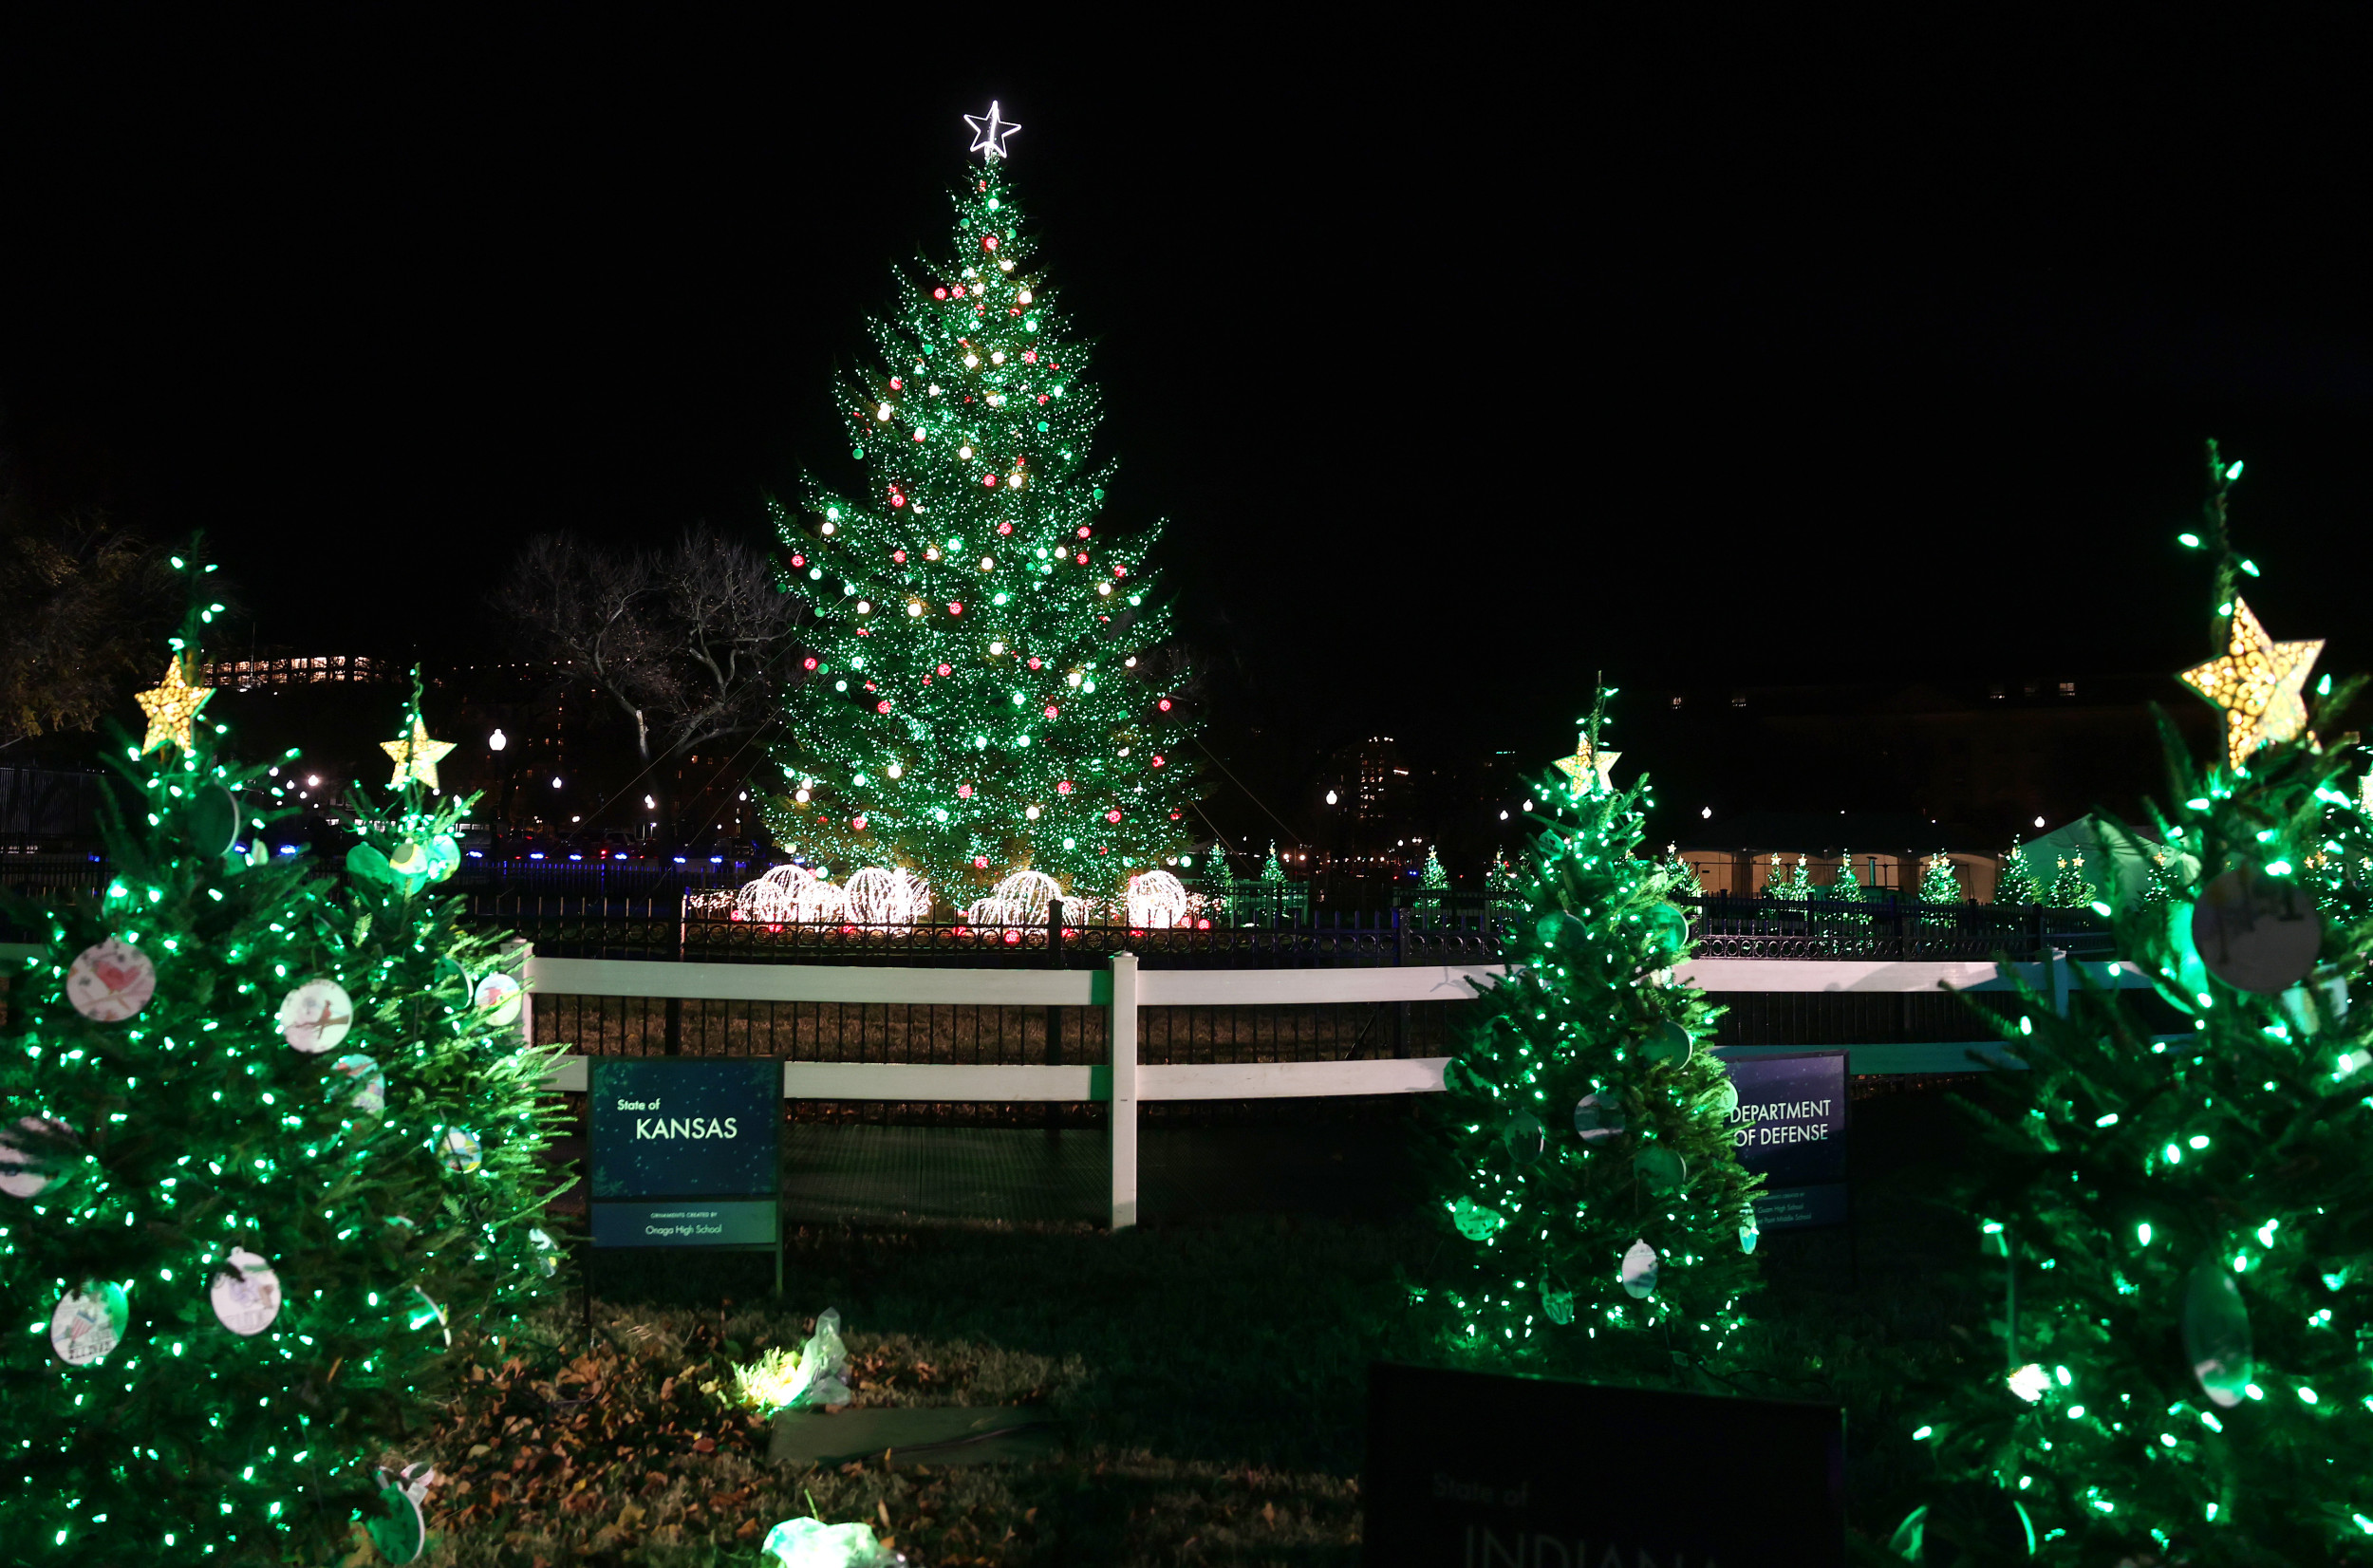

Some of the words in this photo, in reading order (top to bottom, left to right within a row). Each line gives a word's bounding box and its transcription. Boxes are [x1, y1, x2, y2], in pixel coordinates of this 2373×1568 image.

[617, 1099, 645, 1111] State
[647, 1098, 661, 1111] of
[1730, 1099, 1832, 1123] DEPARTMENT
[637, 1117, 738, 1140] KANSAS
[1733, 1129, 1756, 1147] OF
[1761, 1123, 1829, 1145] DEFENSE
[645, 1224, 674, 1237] Onaga
[675, 1224, 694, 1236] High
[696, 1223, 722, 1234] School
[1432, 1471, 1494, 1503] State
[1504, 1480, 1529, 1507] of
